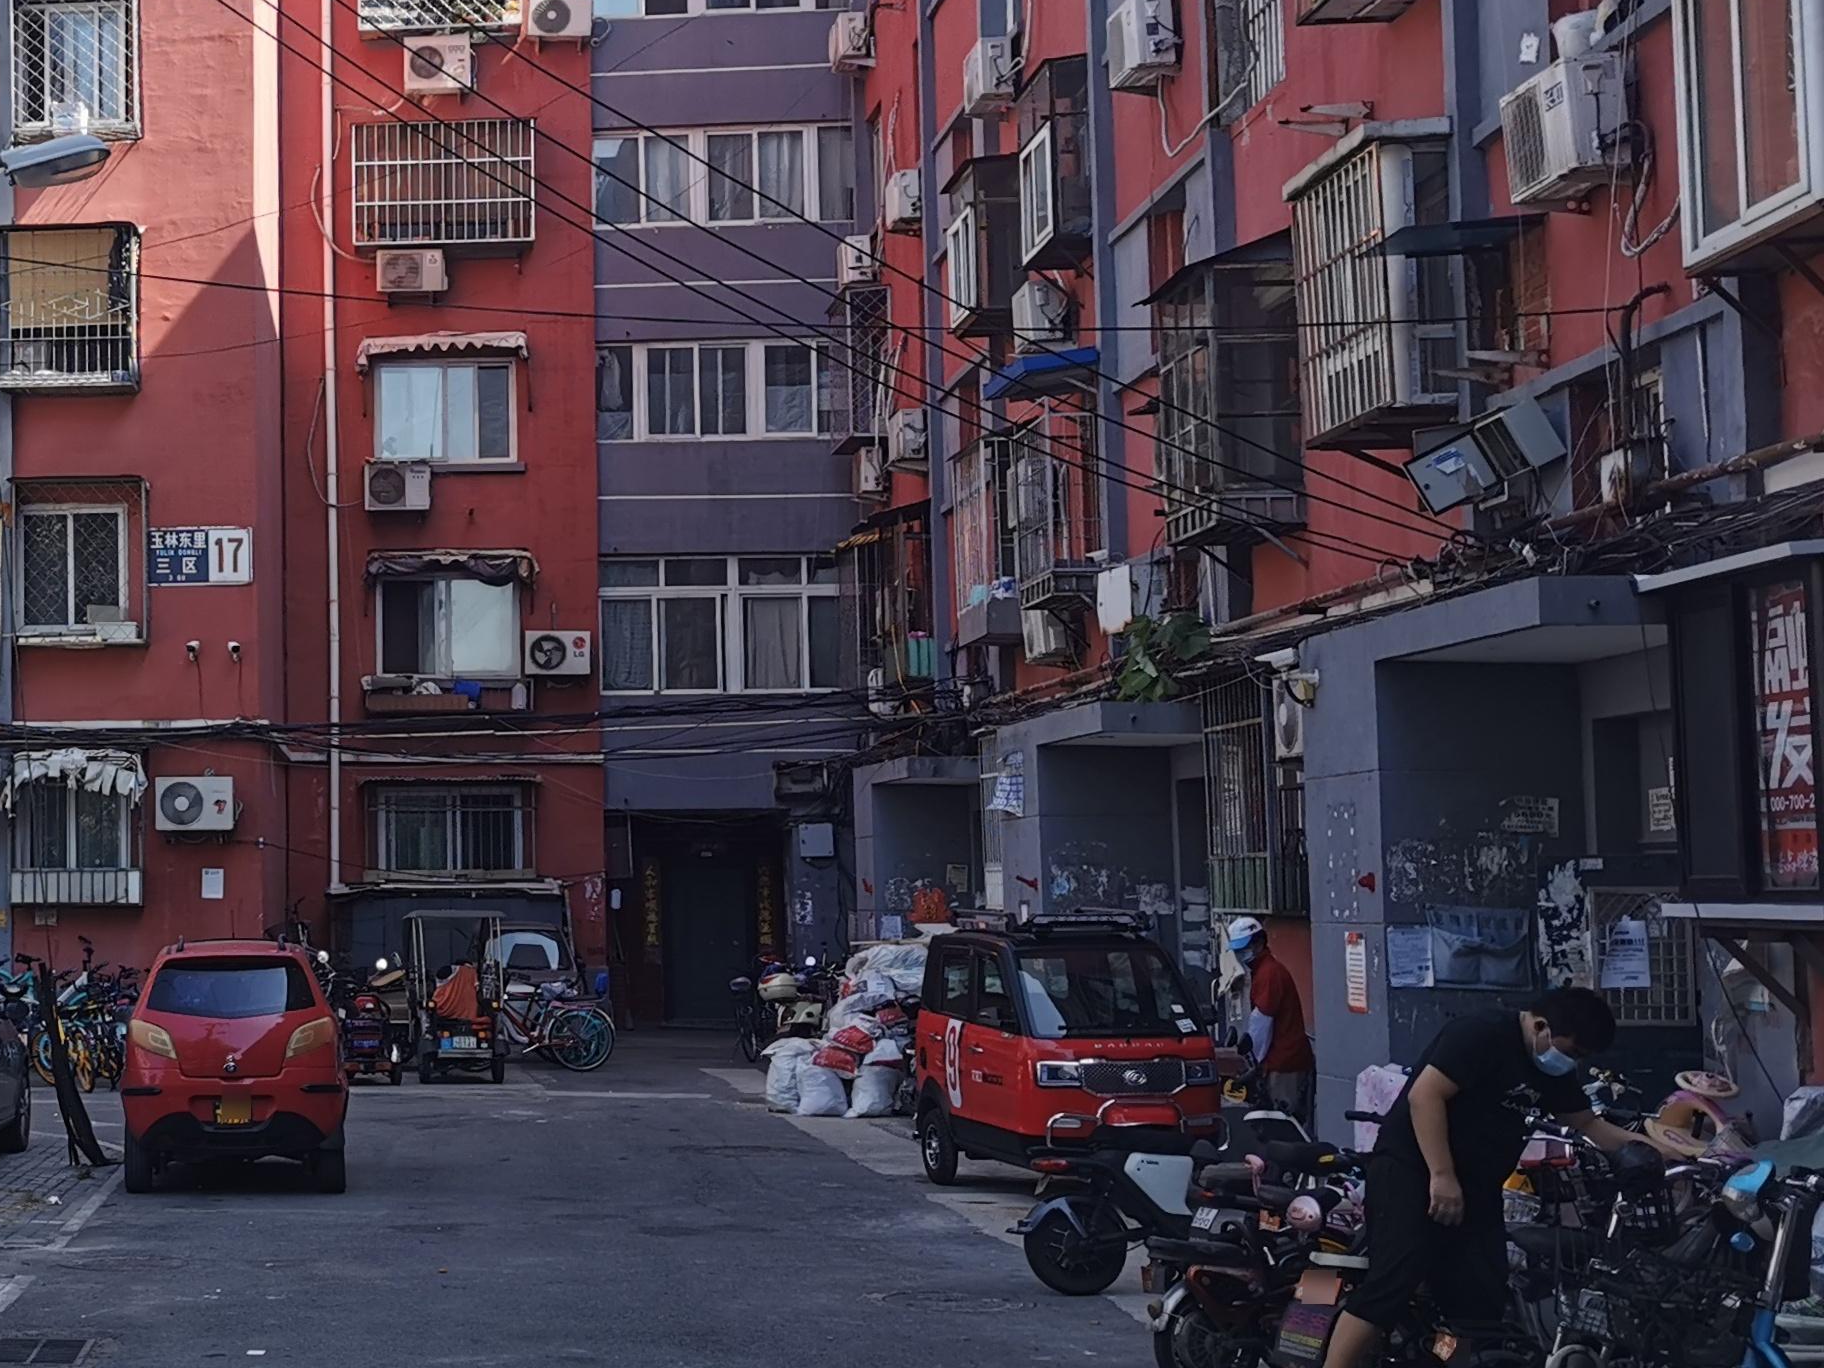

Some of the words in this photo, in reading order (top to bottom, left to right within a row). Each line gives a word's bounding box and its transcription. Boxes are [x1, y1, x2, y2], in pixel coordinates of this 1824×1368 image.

[150, 531, 207, 549] 玉林东里
[214, 537, 244, 573] 17
[156, 558, 171, 574] 三
[182, 557, 197, 574] 区
